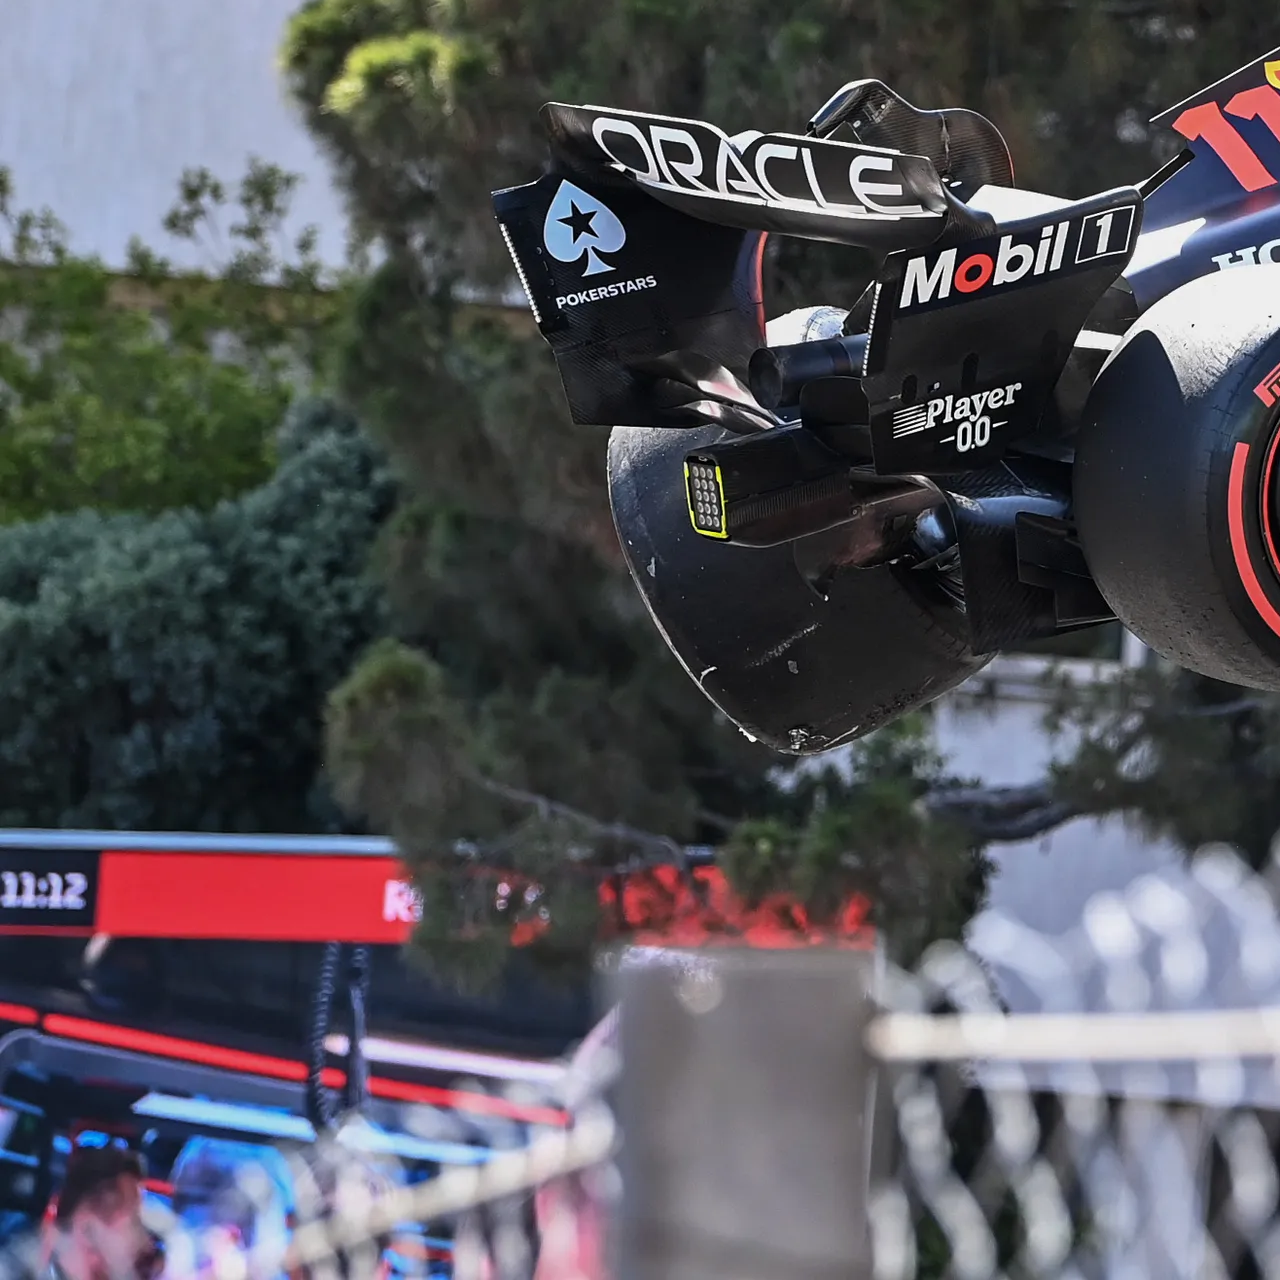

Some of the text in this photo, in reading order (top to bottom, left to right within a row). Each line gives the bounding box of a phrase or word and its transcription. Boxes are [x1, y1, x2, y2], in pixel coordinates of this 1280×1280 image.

[592, 117, 924, 215] ORACLE
[898, 213, 1114, 310] Mobil 1
[555, 274, 658, 310] POKERSTARS
[924, 381, 1023, 429] Player
[0, 871, 88, 910] 11:12
